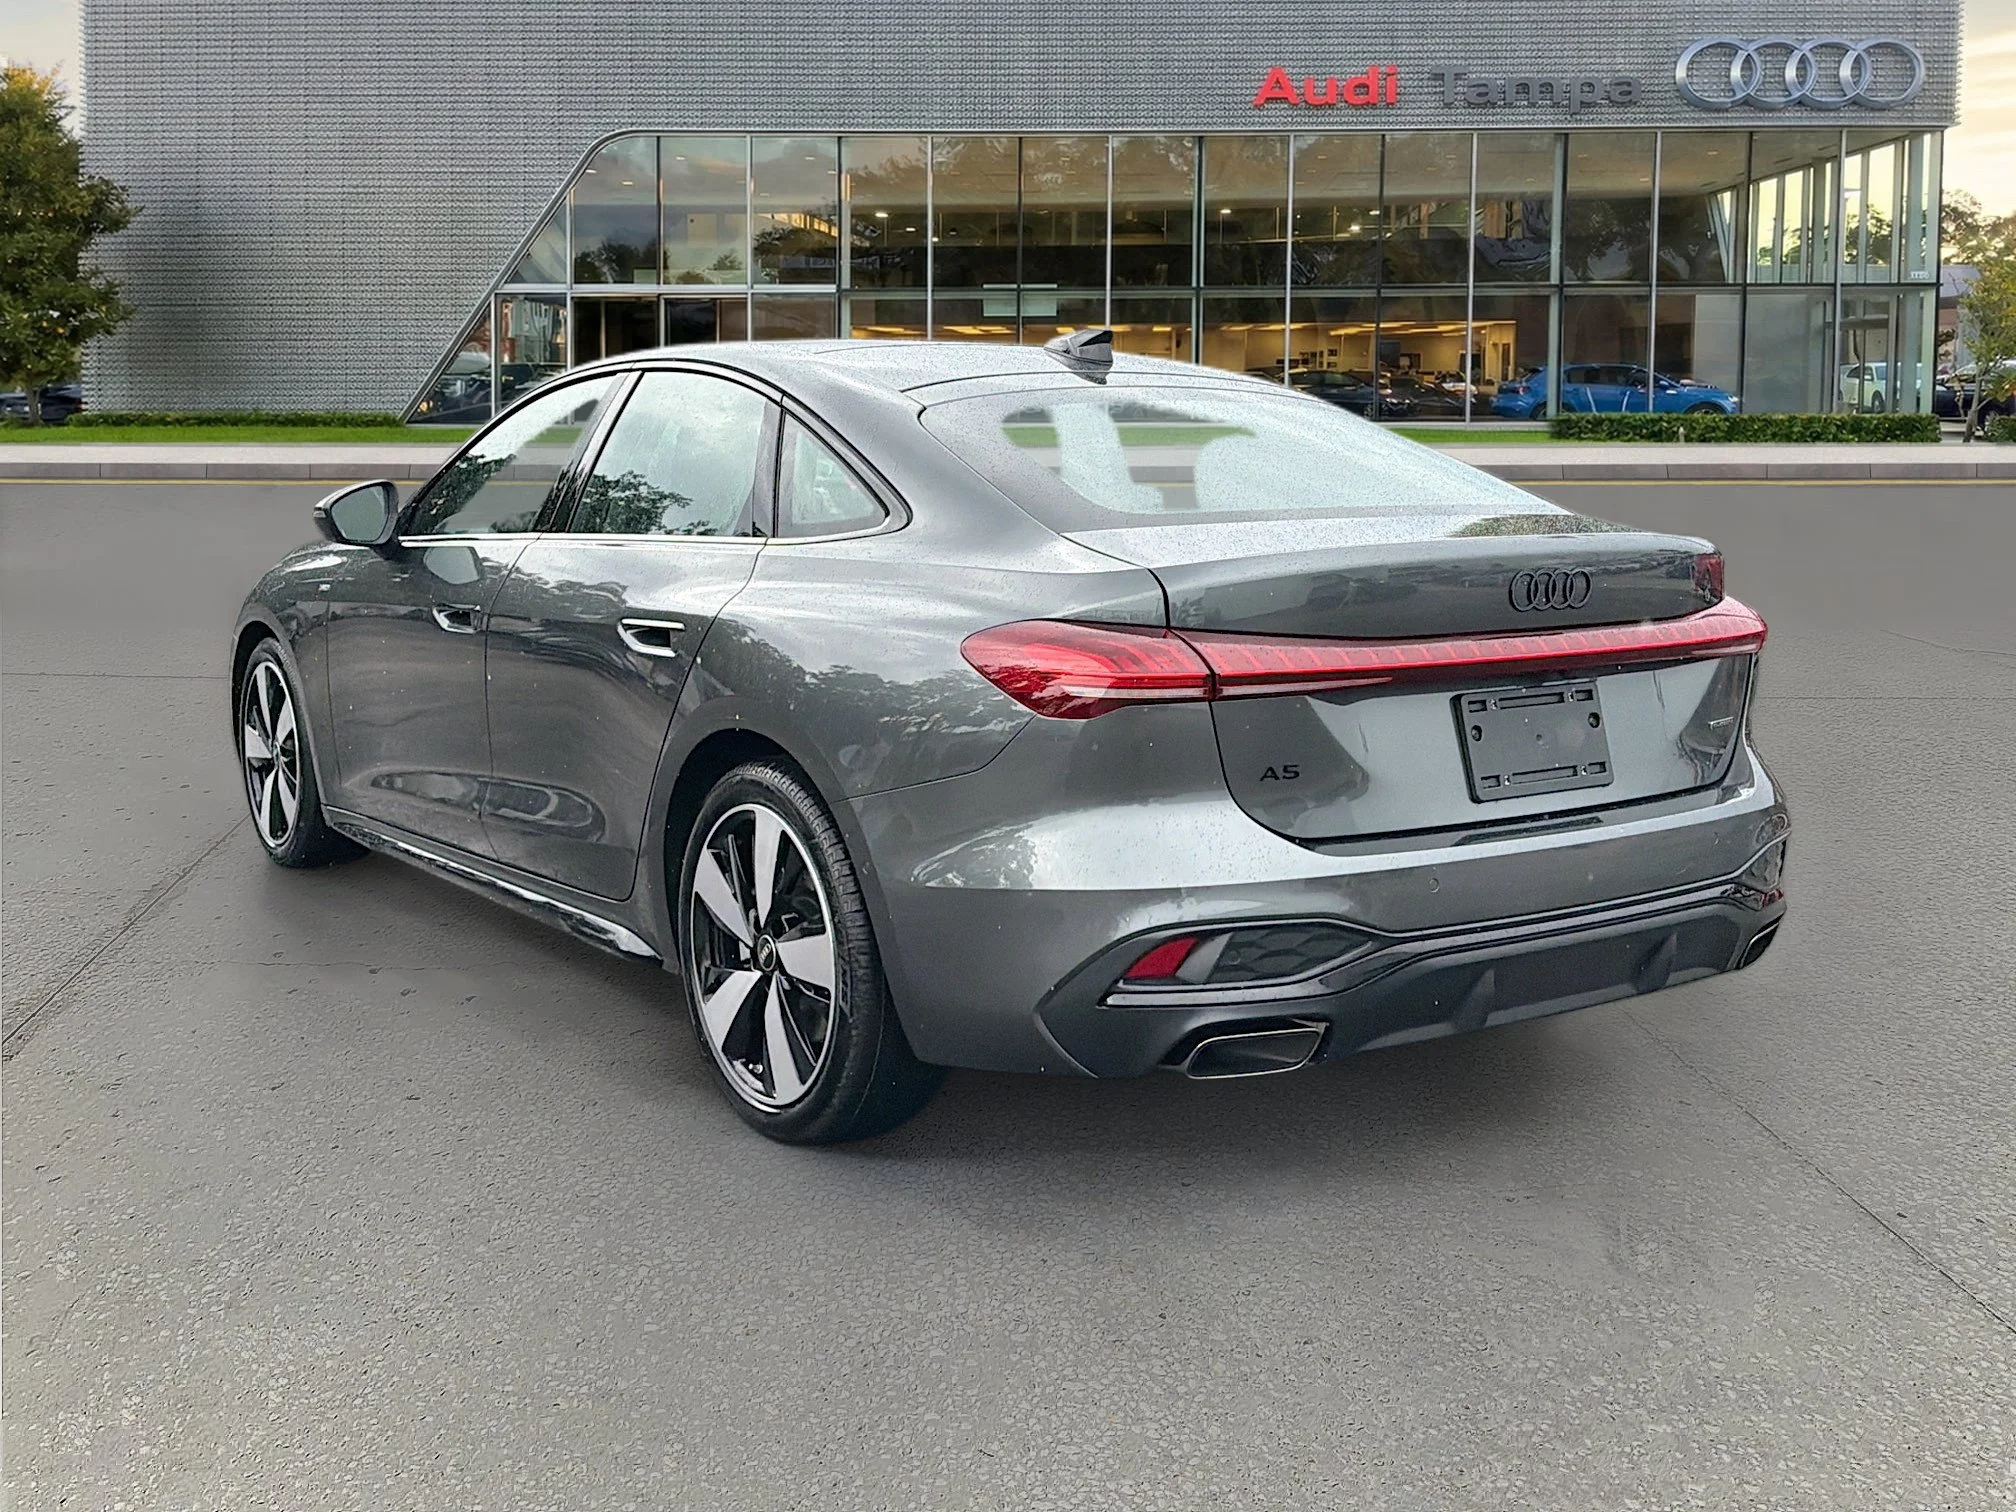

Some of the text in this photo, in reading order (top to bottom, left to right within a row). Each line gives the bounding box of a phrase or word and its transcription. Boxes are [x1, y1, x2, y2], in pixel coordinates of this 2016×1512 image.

[1253, 64, 1641, 115] Audi Tampa
[1260, 764, 1300, 781] A5
